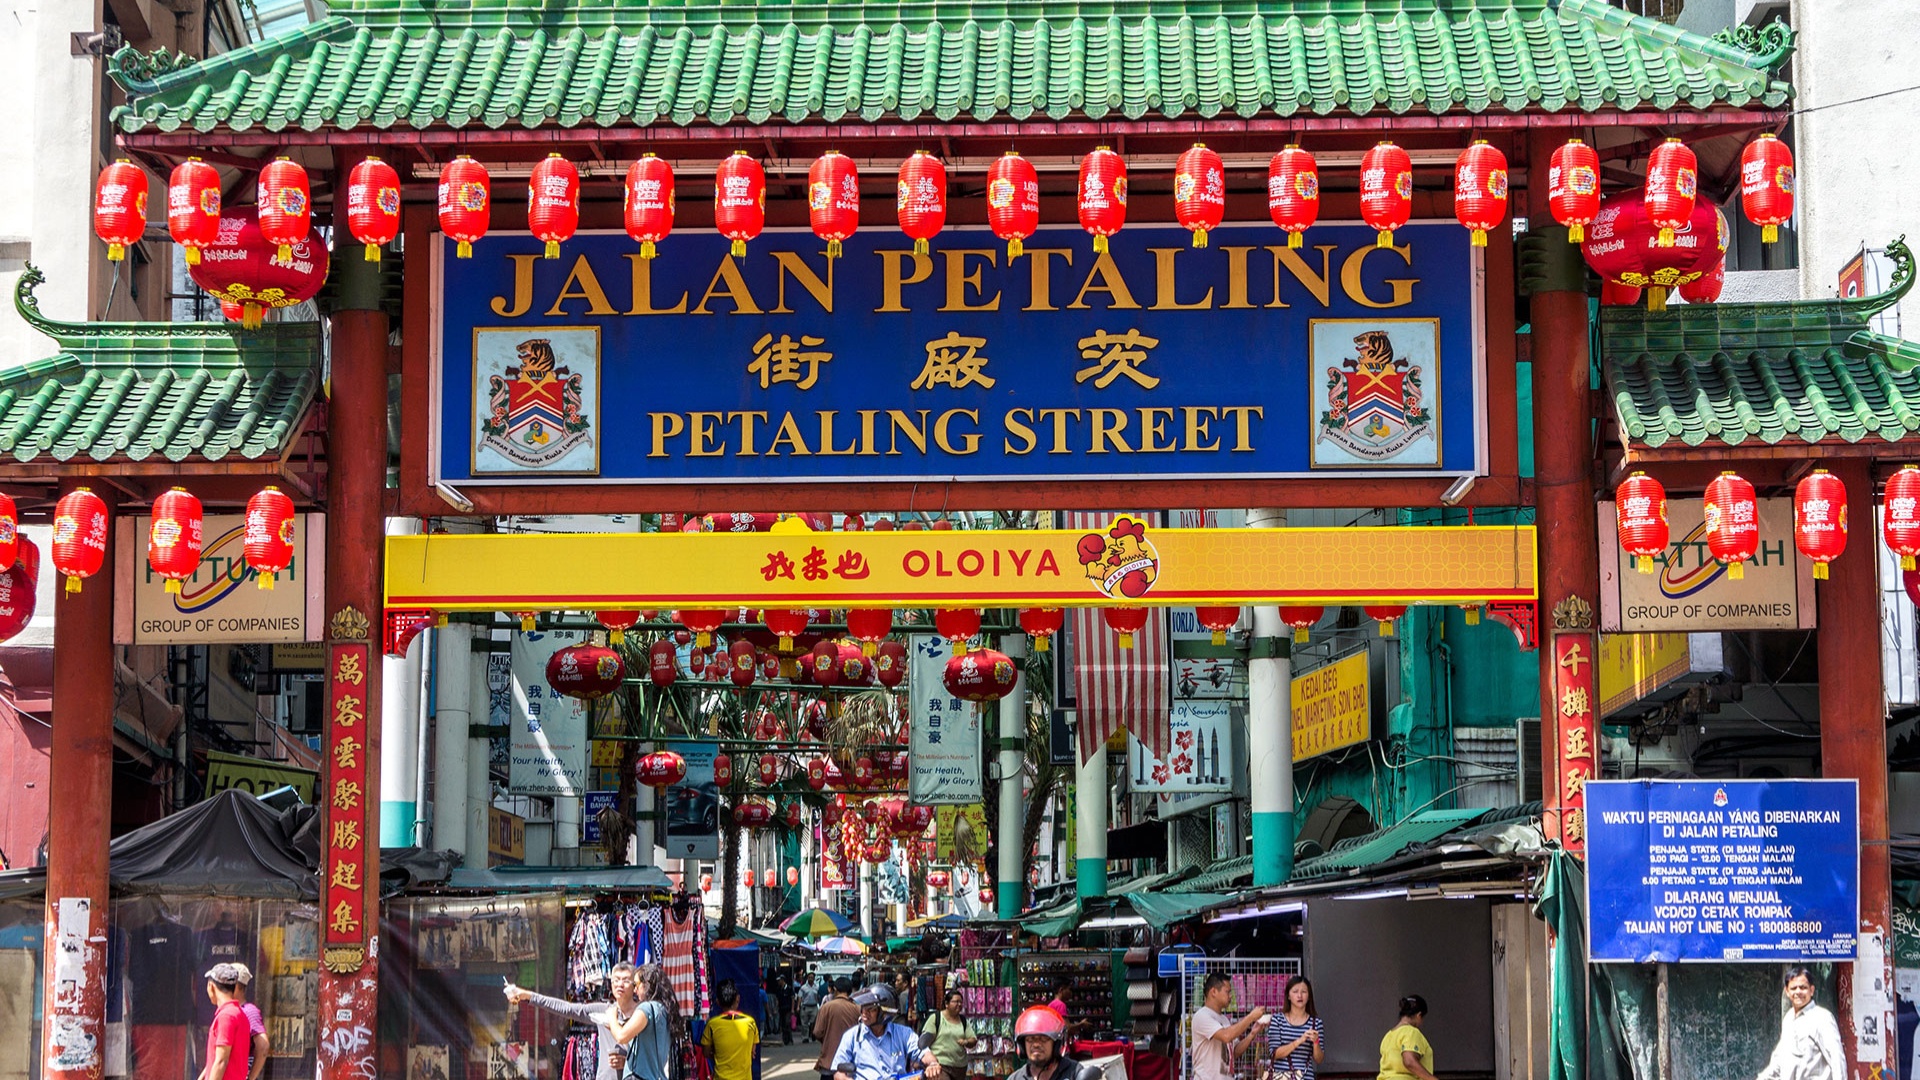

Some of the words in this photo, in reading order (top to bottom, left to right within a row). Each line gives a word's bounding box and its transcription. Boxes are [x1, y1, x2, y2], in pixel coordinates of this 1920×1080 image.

[490, 252, 834, 317] JALAN
[873, 245, 1421, 313] PETALING
[646, 408, 983, 458] PETALING
[1003, 406, 1264, 456] STREET
[1325, 428, 1348, 445] Dewan
[1348, 442, 1385, 458] Bandaraya
[1385, 443, 1404, 455] Kuala
[1403, 425, 1428, 444] Lumpur
[486, 435, 508, 452] Dewan
[508, 447, 544, 465] Bandaraya
[544, 449, 563, 461] Kuala
[562, 432, 587, 451] Lumpur
[903, 549, 1060, 577] OLOIYA
[1627, 605, 1679, 619] GROUP
[1683, 605, 1703, 618] OF
[1707, 603, 1792, 618] COMPANIES
[141, 620, 191, 633] GROUP
[195, 619, 214, 631] OF
[218, 617, 300, 632] COMPANIES
[1301, 674, 1322, 703] KEDAI
[1323, 667, 1338, 694] BEG
[1305, 694, 1337, 728] MARKETING
[513, 757, 531, 765] Your
[537, 768, 549, 777] My
[552, 769, 576, 778] Glory
[915, 766, 932, 775] Your
[935, 767, 965, 776] Health,
[938, 777, 950, 787] My
[952, 777, 975, 788] Glory
[1602, 811, 1644, 823] WAKTU
[1649, 811, 1724, 823] PERNIAGAAN
[1764, 811, 1841, 823] DIBENARKAN
[1663, 825, 1675, 837] DI
[1679, 825, 1718, 837] JALAN
[1722, 825, 1778, 837] PETALING
[1649, 845, 1687, 855] PENJAJA
[1690, 845, 1719, 855] STATIK
[1722, 845, 1735, 855] (DI
[1736, 845, 1760, 855] BAHU
[1763, 845, 1796, 855] JALAN)
[1670, 854, 1689, 863] PAGI
[1701, 854, 1720, 863] 12.00
[1724, 854, 1760, 863] TENGAH
[1762, 854, 1795, 863] MALAM
[1649, 866, 1688, 875] PENJAJA
[1690, 866, 1719, 875] STATIK
[1722, 866, 1735, 875] (DI
[1737, 866, 1758, 875] ATAS
[1761, 866, 1793, 875] JALAN)
[1661, 876, 1696, 885] PETANG
[1708, 876, 1728, 885] 12.00
[1731, 876, 1767, 885] TENGAH
[1770, 876, 1803, 885] MALAM
[1664, 892, 1724, 904] DILARANG
[1729, 892, 1782, 904] MENJUAL
[1654, 906, 1697, 919] VCD/CD
[1702, 906, 1740, 919] CETAK
[1744, 906, 1793, 919] ROMPAK
[1624, 921, 1666, 934] TALIAN
[1669, 921, 1692, 934] HOT
[1698, 921, 1723, 934] LINE
[1728, 921, 1746, 934] NO
[1759, 921, 1823, 934] 1800886800
